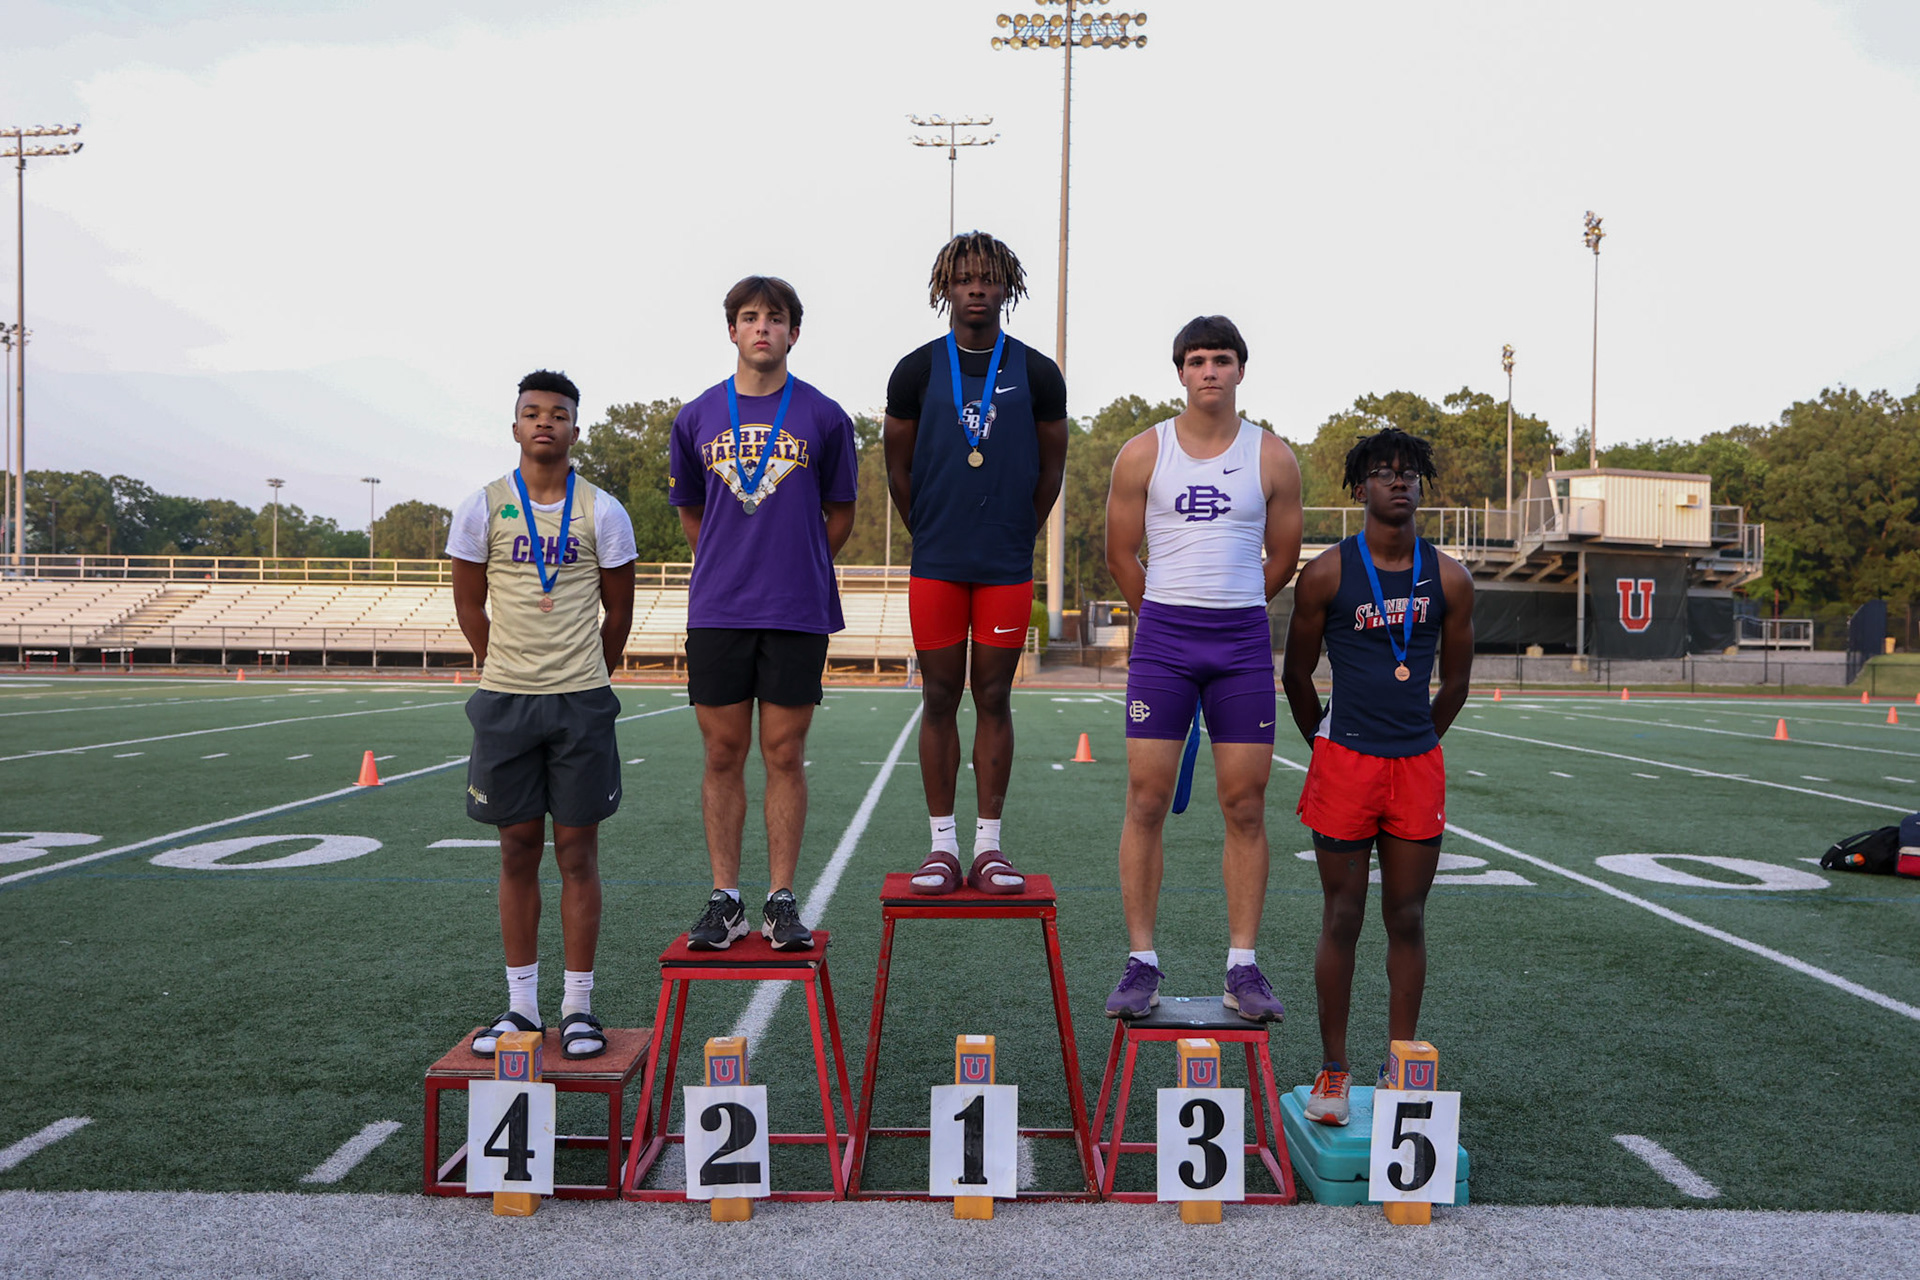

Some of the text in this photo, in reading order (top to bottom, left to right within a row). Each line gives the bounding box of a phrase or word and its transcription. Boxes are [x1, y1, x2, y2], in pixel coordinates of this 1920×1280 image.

[1372, 613, 1406, 628] EAGLE
[1616, 578, 1655, 632] U
[502, 1054, 525, 1078] U
[713, 1058, 736, 1083] U
[963, 1056, 987, 1080] U
[1189, 1060, 1214, 1084] U
[1408, 1063, 1431, 1087] U
[484, 1092, 535, 1181] 4
[700, 1102, 761, 1185] 2
[954, 1095, 988, 1185] 1
[1178, 1098, 1227, 1189] 3
[1387, 1101, 1436, 1191] 5
